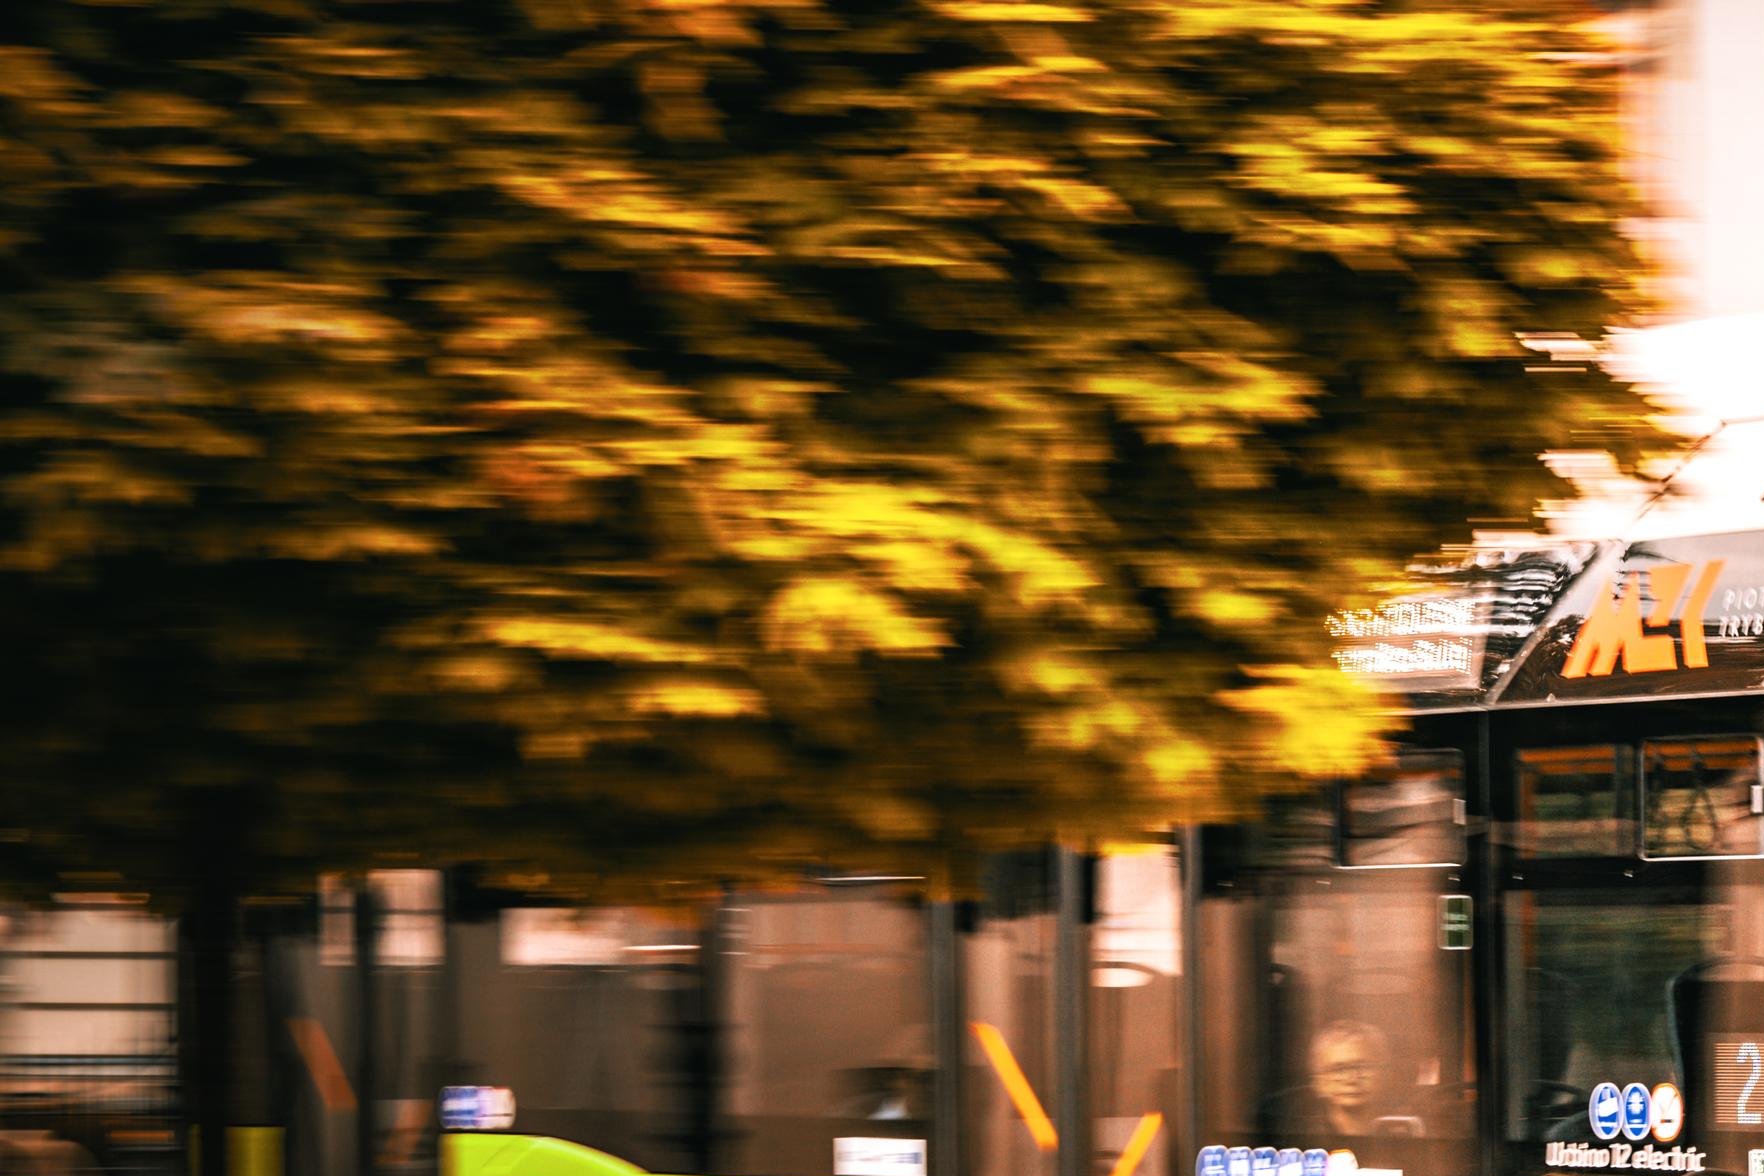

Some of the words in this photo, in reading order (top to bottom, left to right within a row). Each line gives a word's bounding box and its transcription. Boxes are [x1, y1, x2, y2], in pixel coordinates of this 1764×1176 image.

[1736, 1042, 1763, 1124] 2
[1545, 1141, 1610, 1168] Urbino
[1609, 1142, 1632, 1168] 12
[1631, 1143, 1707, 1172] electric
